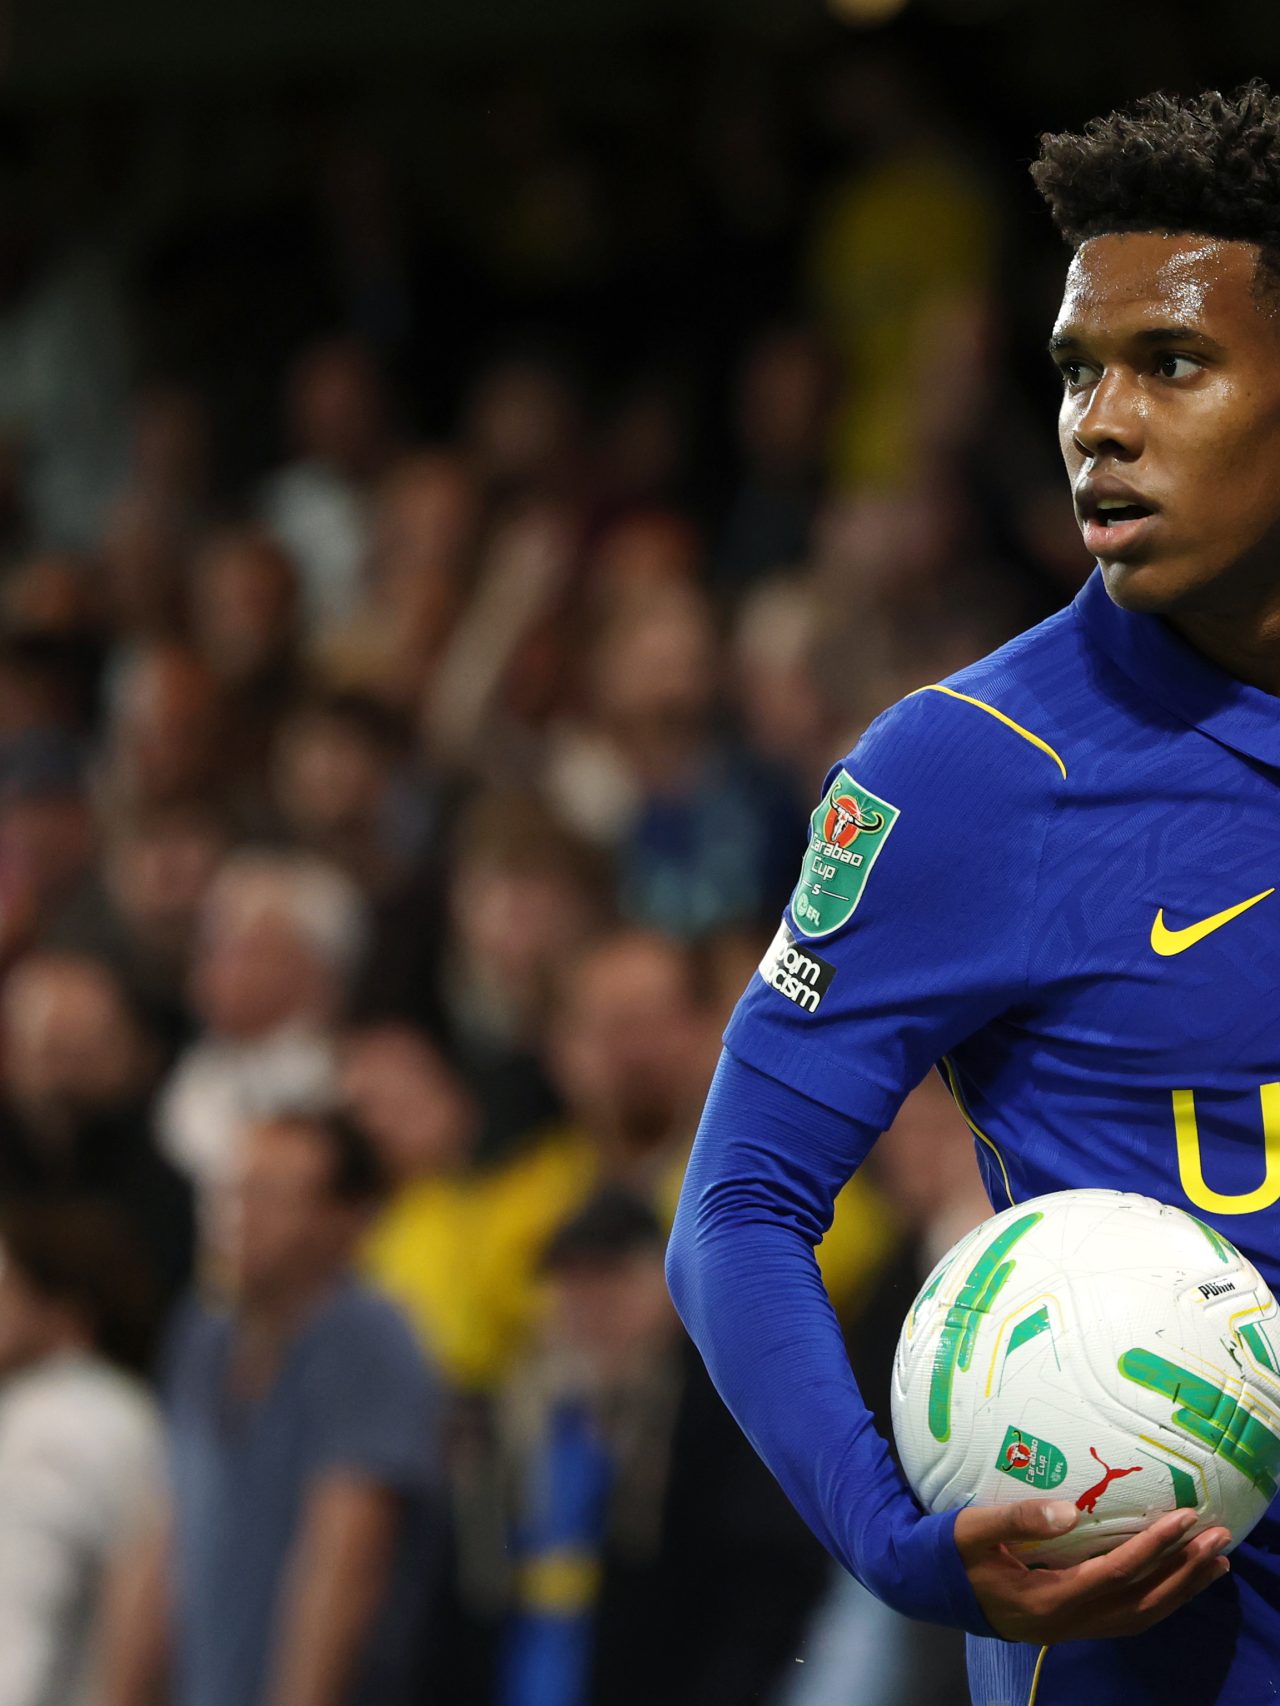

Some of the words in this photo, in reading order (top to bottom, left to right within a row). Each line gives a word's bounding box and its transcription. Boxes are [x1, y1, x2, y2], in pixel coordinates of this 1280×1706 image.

[810, 833, 863, 867] Carabao
[811, 855, 836, 880] Cup
[1026, 1439, 1039, 1483] Carabao
[1036, 1456, 1048, 1476] Cup
